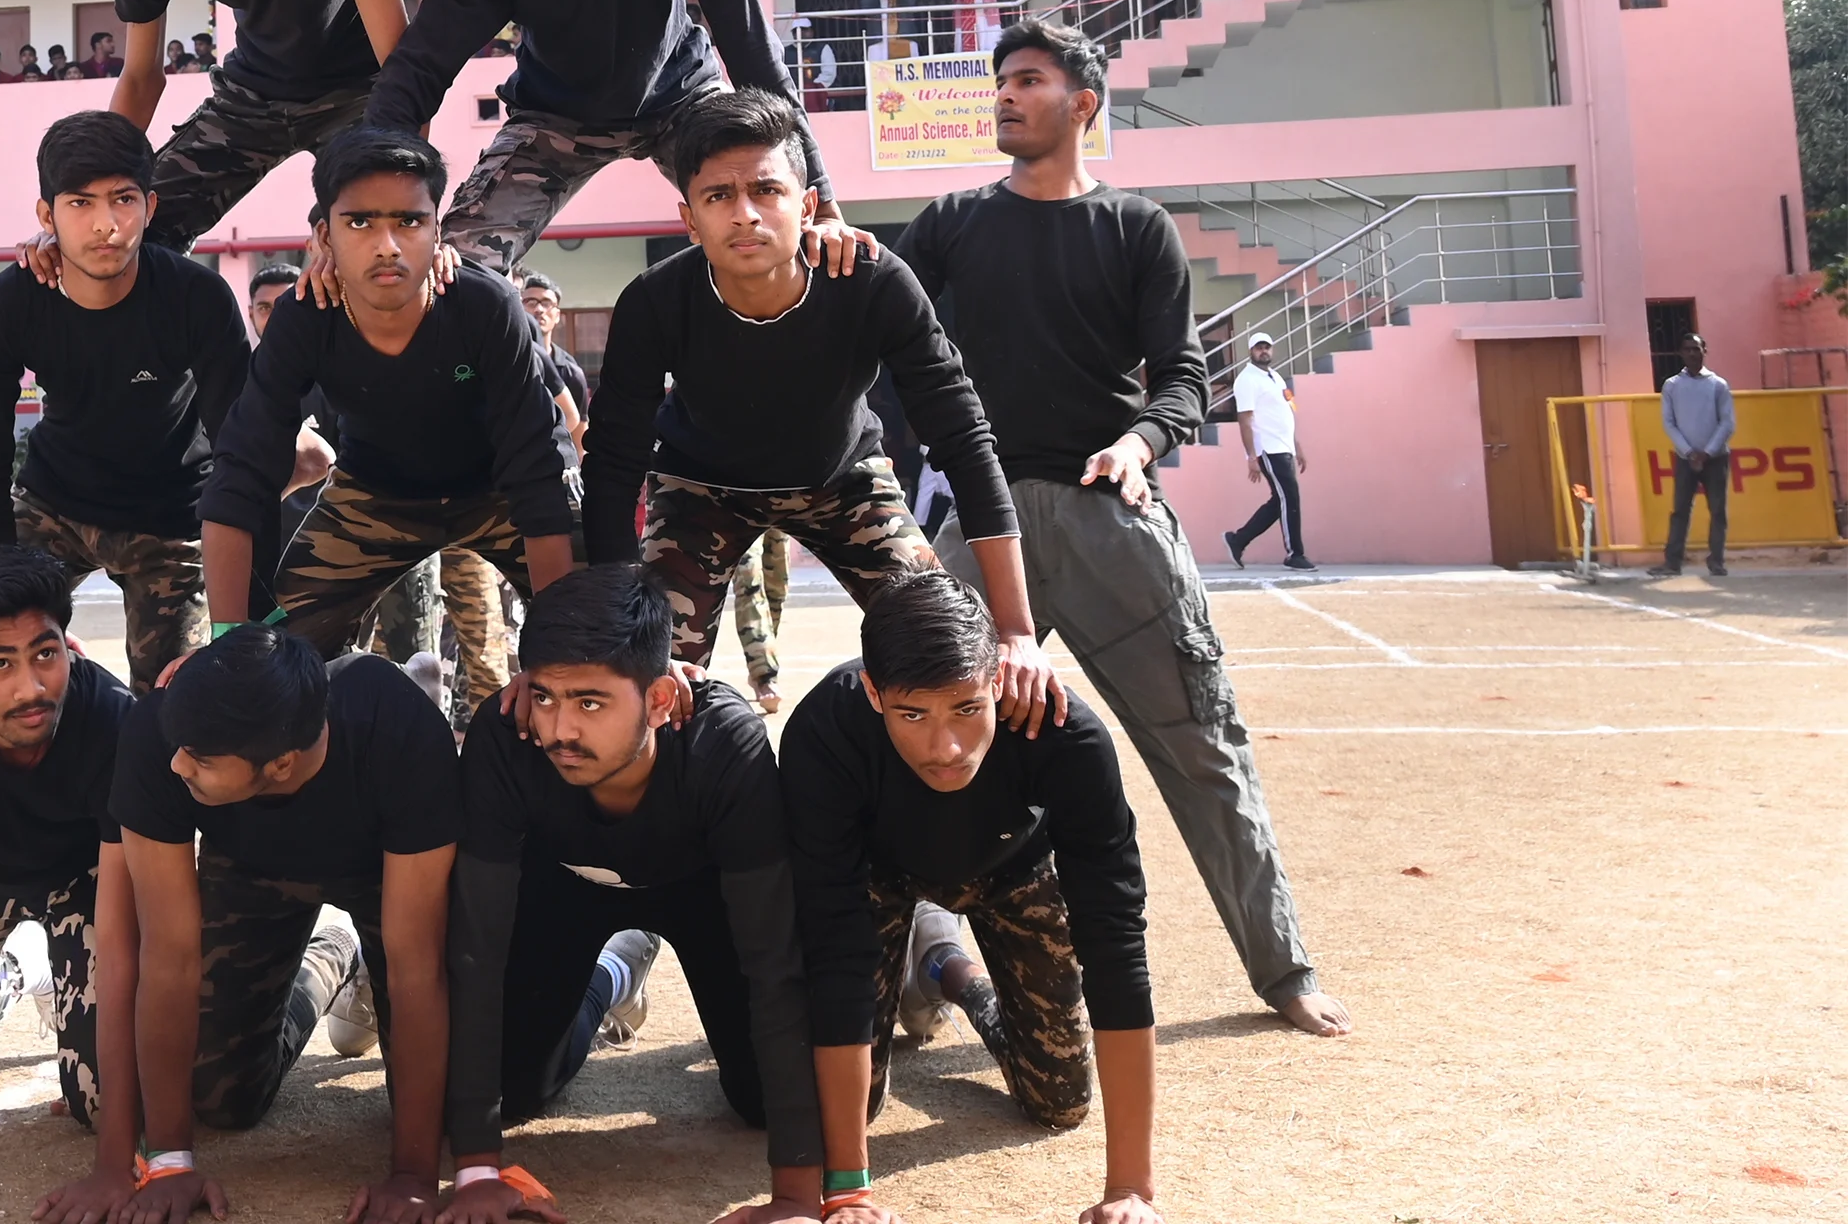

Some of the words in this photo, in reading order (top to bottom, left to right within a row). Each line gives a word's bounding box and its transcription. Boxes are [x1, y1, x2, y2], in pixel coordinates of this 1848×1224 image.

[895, 63, 919, 81] H.S.
[922, 59, 989, 80] MEMORIAL
[953, 106, 970, 115] the
[879, 123, 919, 142] Annual
[922, 121, 972, 141] Science,
[976, 119, 993, 137] Art
[906, 148, 946, 159] 22/12/22
[1647, 446, 1815, 495] HPS
